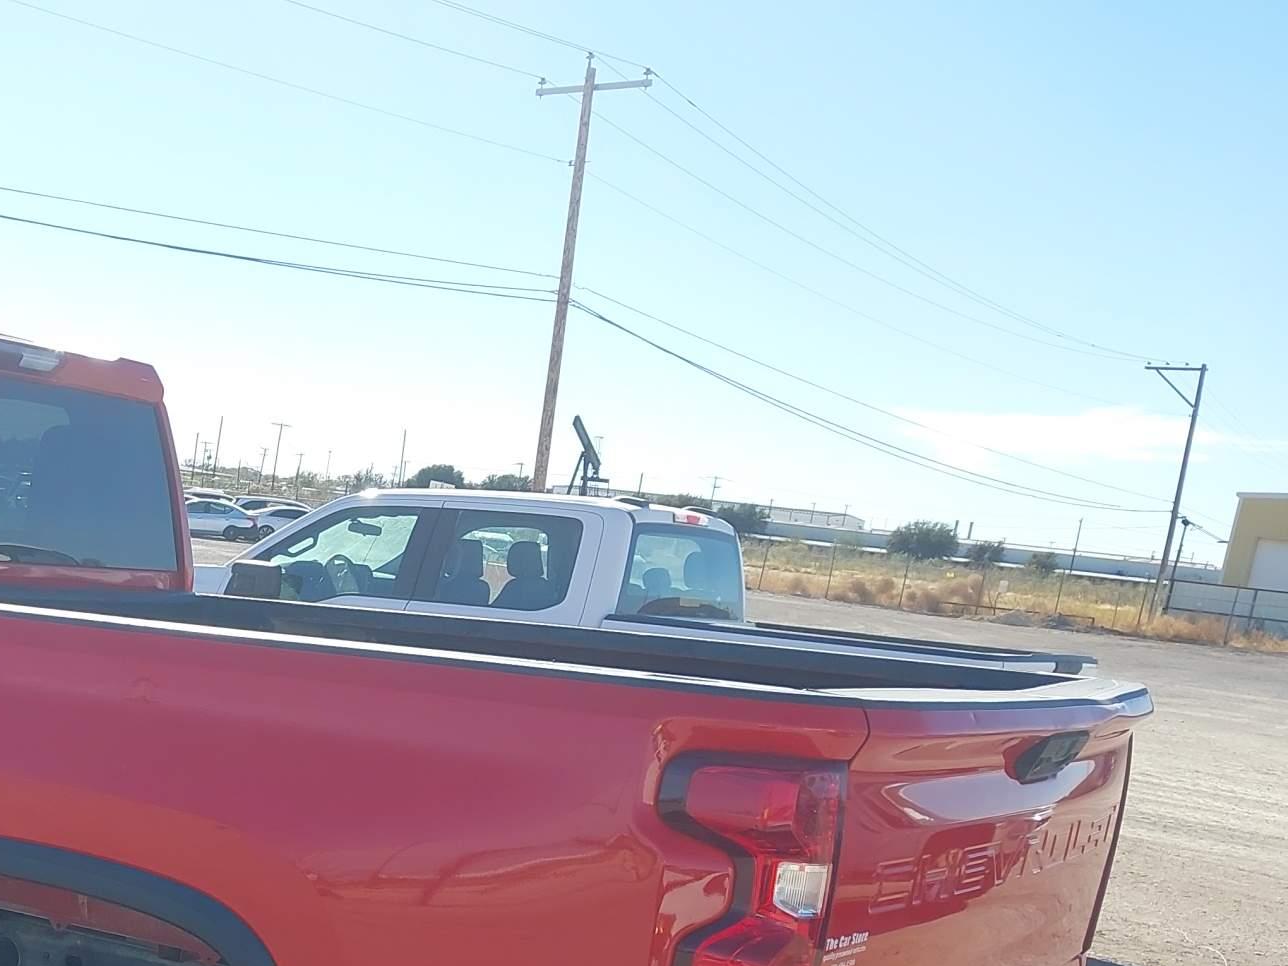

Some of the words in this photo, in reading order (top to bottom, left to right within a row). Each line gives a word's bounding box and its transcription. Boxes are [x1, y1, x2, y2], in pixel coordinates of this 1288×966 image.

[868, 804, 1119, 914] CHEVROLET
[825, 938, 839, 951] The
[839, 935, 851, 948] Car
[851, 931, 870, 945] Store
